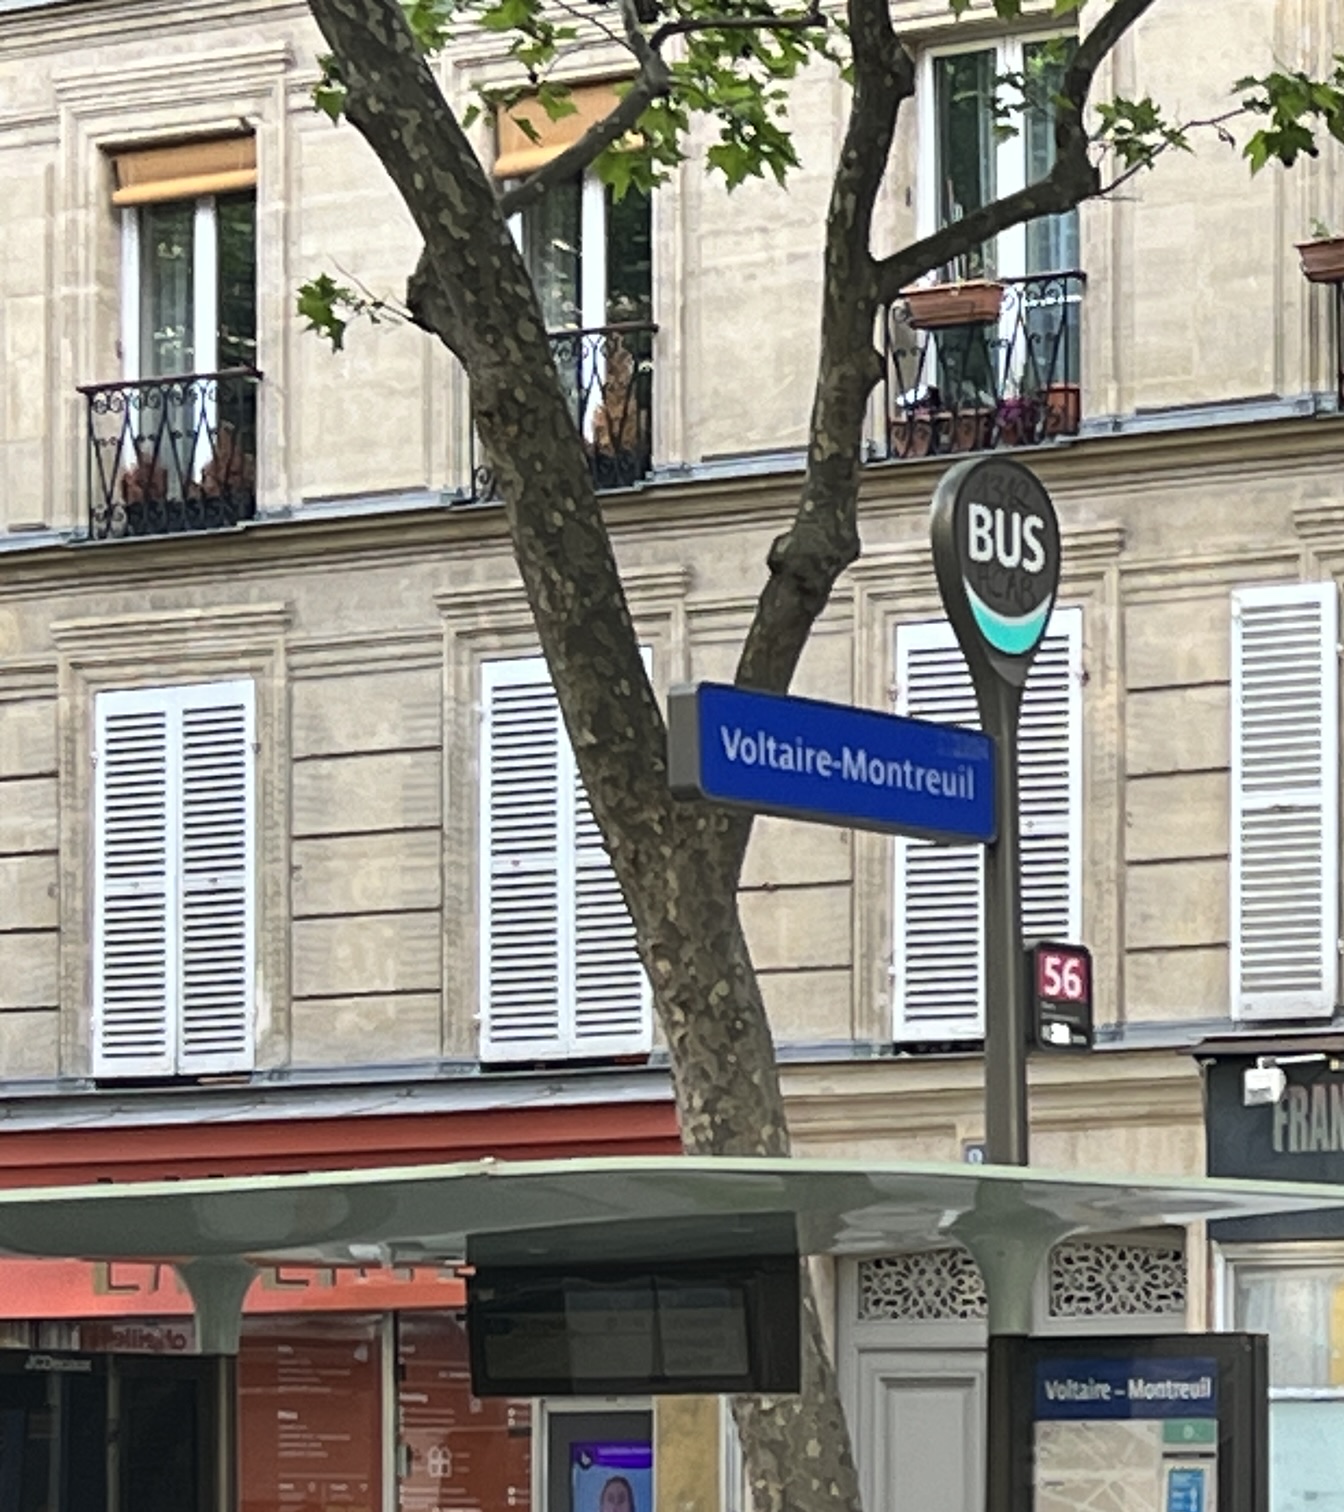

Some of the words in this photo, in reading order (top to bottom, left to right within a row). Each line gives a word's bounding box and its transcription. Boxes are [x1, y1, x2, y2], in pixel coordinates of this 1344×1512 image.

[967, 502, 1047, 574] BUS
[720, 725, 976, 801] Voltaire-Montreuil
[1043, 955, 1082, 999] 56
[1045, 1377, 1112, 1401] Voltaire
[1128, 1377, 1212, 1401] Montreuil
